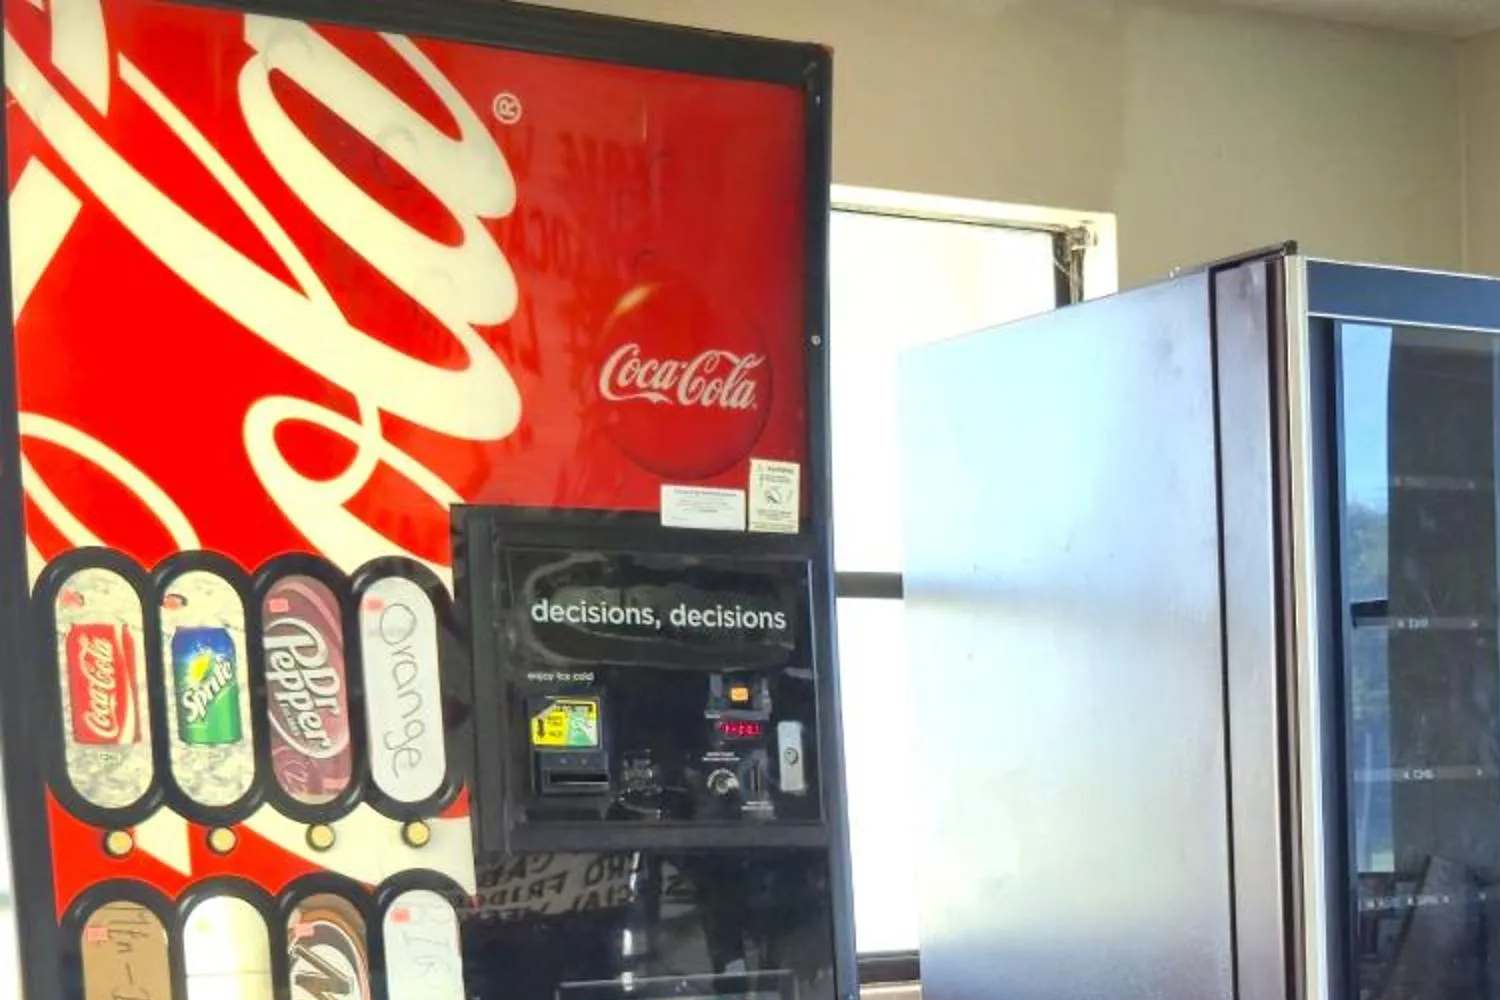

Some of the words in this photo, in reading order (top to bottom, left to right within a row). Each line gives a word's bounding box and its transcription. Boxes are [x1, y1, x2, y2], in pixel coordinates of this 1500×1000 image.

[600, 343, 766, 410] Coca-Cola
[531, 600, 662, 629] decisions,
[669, 603, 787, 630] decisions
[181, 655, 236, 725] Sprite
[265, 617, 334, 751] Pepper
[380, 603, 424, 778] Orange
